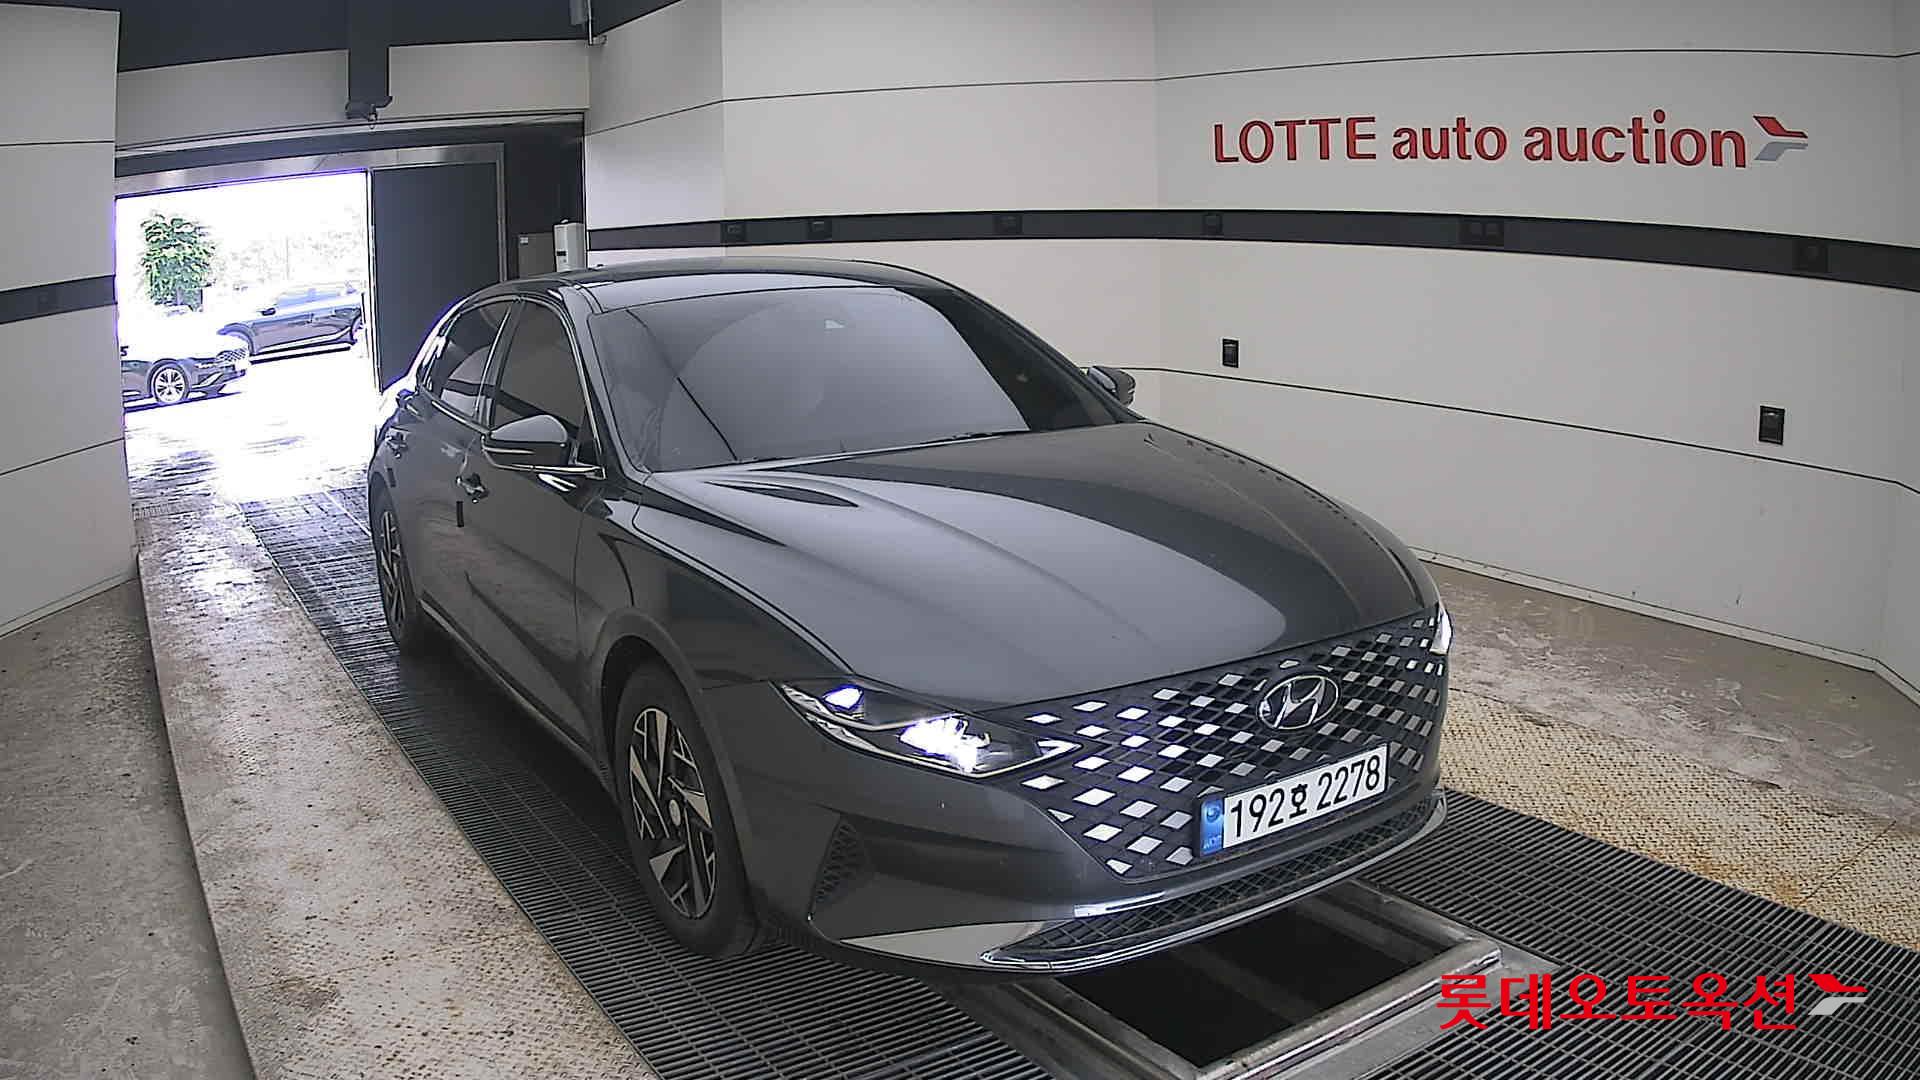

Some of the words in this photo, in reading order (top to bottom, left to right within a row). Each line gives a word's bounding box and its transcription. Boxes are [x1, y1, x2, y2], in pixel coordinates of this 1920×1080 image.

[1214, 116, 1377, 163] LOTTE
[1392, 117, 1507, 162] auto
[1523, 109, 1746, 168] auction
[1230, 783, 1308, 839] 192호
[1316, 754, 1381, 811] 2278
